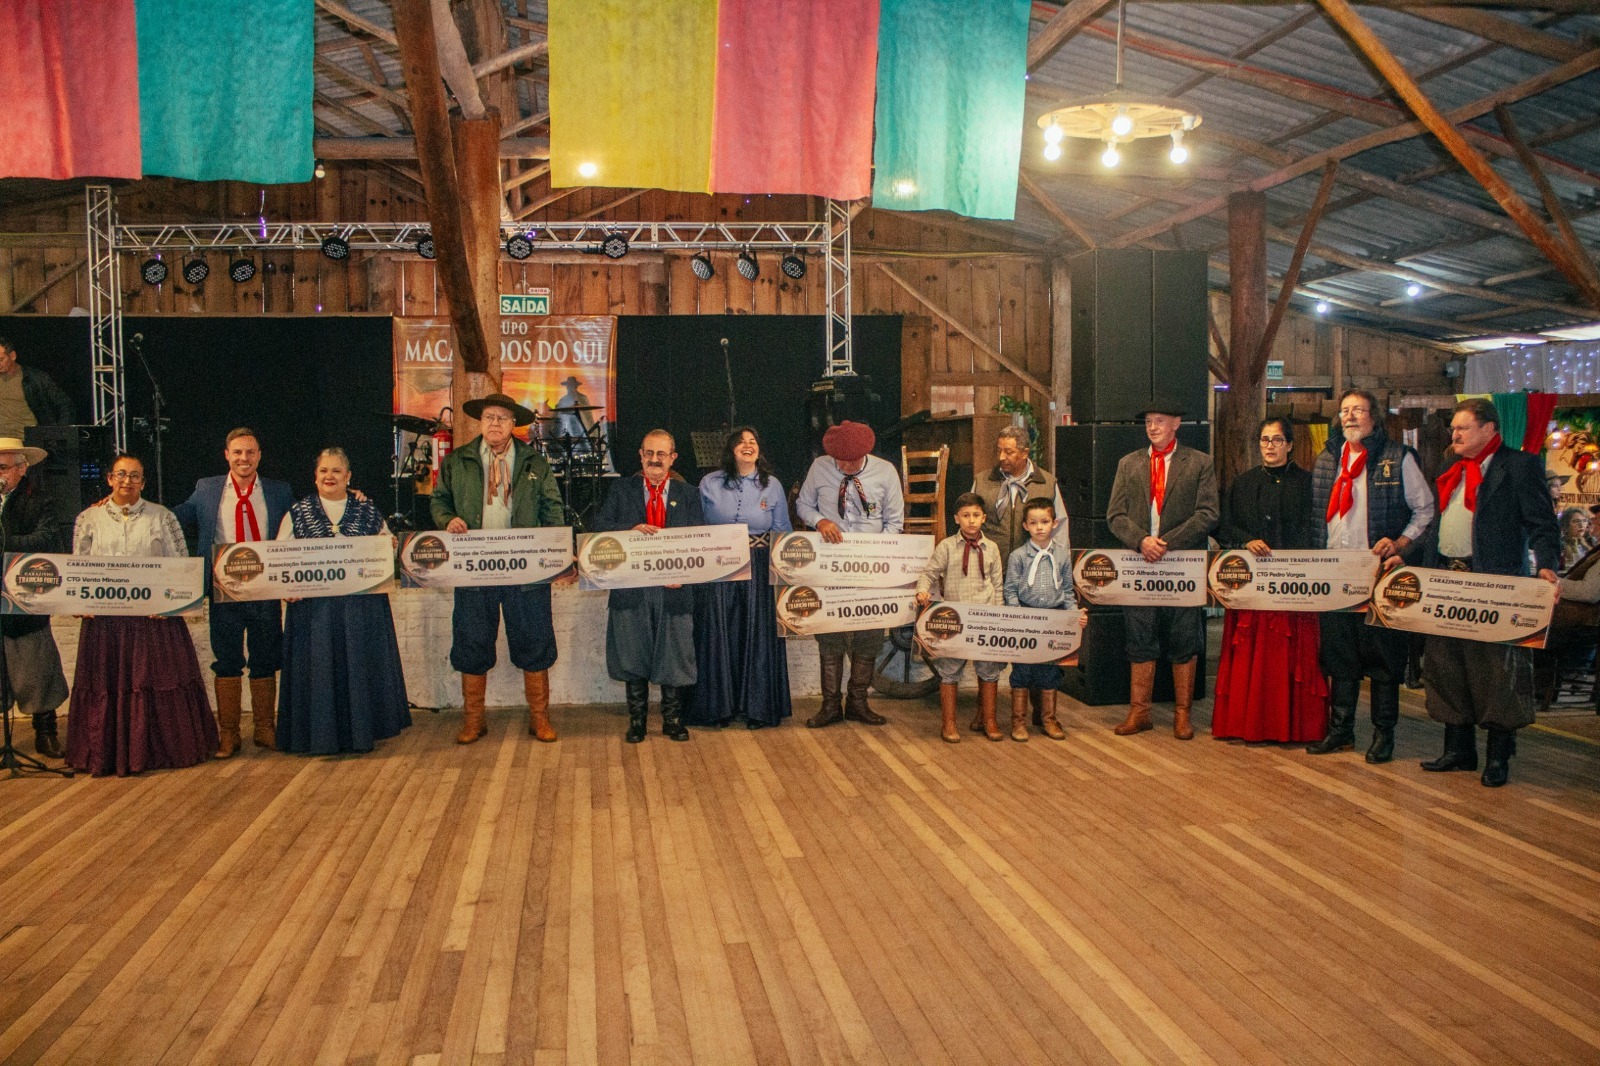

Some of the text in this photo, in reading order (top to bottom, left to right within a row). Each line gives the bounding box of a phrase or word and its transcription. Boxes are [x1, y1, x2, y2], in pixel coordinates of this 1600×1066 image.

[502, 297, 547, 313] SAÍDA
[502, 322, 528, 335] UPO
[538, 340, 567, 362] DO
[573, 340, 608, 363] SUL
[466, 558, 527, 572] 5.000,00
[644, 556, 705, 571] 5.000,00
[831, 561, 890, 575] 5.000,00
[281, 568, 346, 583] 5.000,00
[1429, 577, 1463, 585] CARAZINHO
[80, 586, 152, 601] 5.000,00
[1134, 580, 1196, 593] 5.000,00
[1268, 582, 1330, 596] 5.000,00
[838, 603, 898, 618] 10.000,00
[1434, 605, 1499, 624] 5.000,00
[977, 634, 1037, 650] 5.000,00
